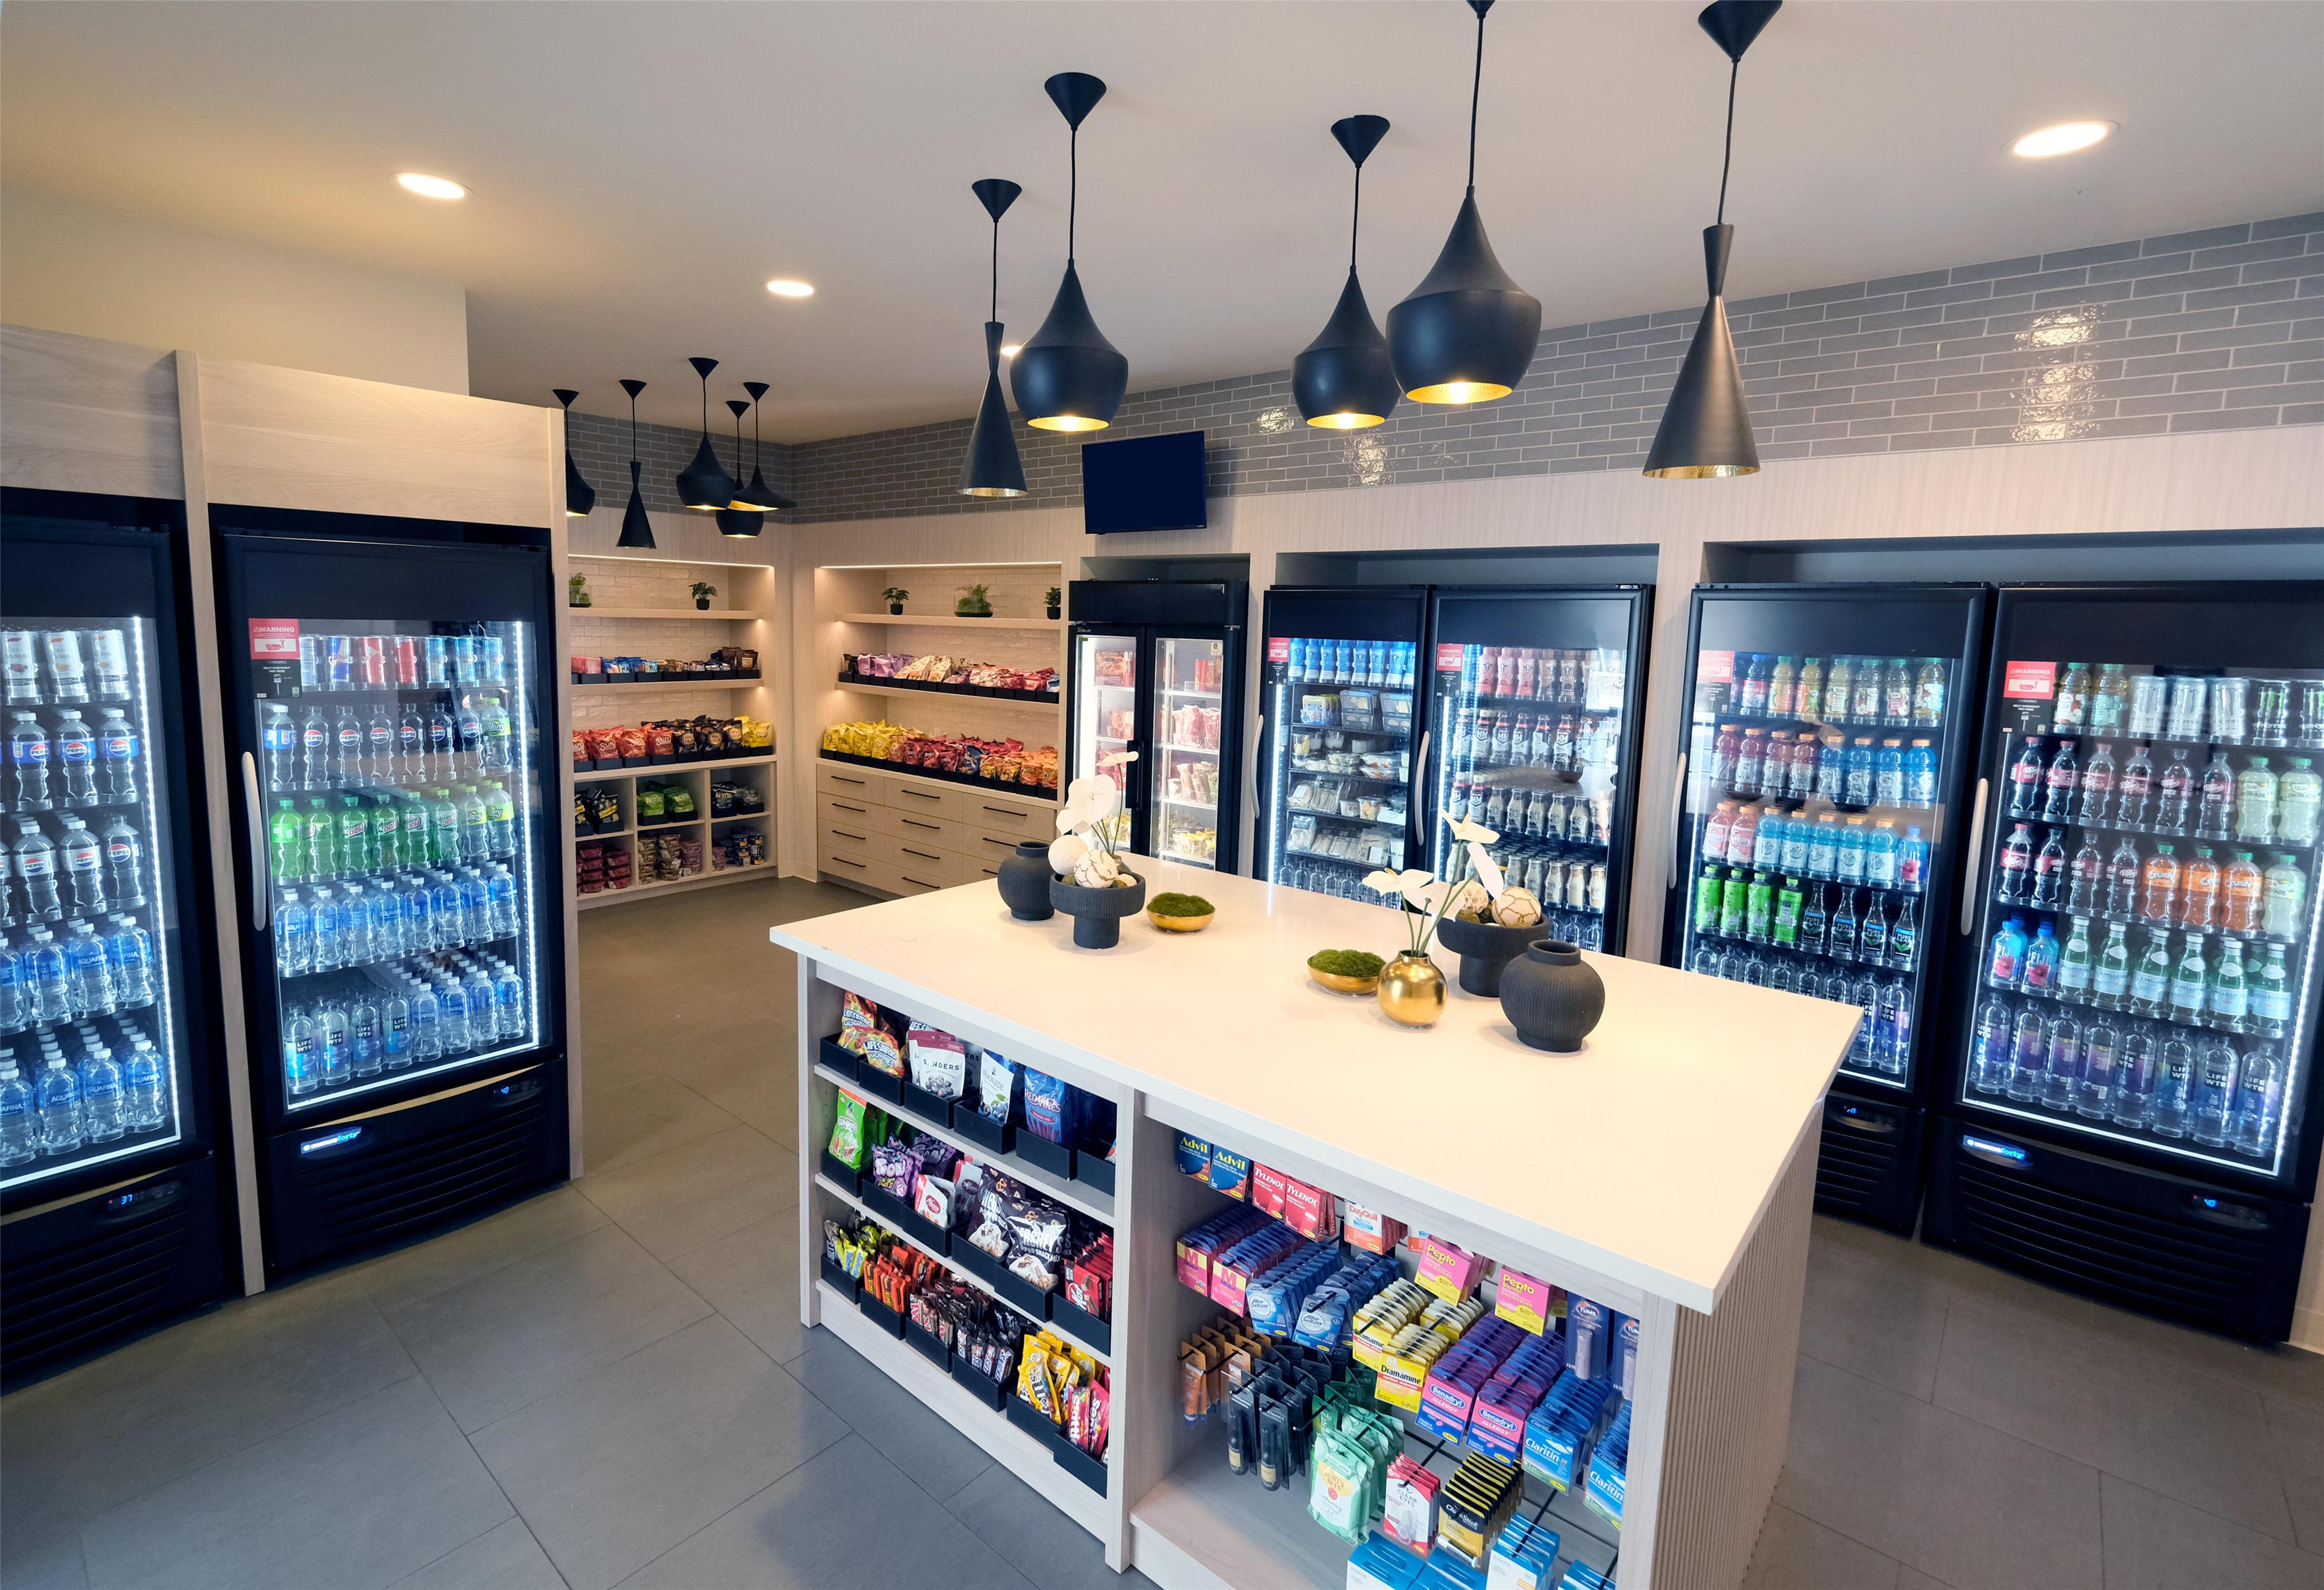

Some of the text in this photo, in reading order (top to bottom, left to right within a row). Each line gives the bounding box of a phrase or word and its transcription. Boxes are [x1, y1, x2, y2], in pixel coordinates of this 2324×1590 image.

[2148, 872, 2173, 880] Crush
[2225, 880, 2252, 889] Crush
[2205, 1079, 2227, 1088] WTR
[2206, 1072, 2227, 1081] LIFE
[2244, 1077, 2265, 1085] LIFE
[501, 1086, 510, 1094] 40
[2243, 1083, 2264, 1093] WTR
[1180, 1137, 1208, 1154] Advil
[1215, 1151, 1246, 1170] Advil
[1255, 1167, 1285, 1190] TYLENOL
[120, 1195, 133, 1205] 37
[1287, 1183, 1318, 1207] TYLENOL
[1349, 1204, 1378, 1222] DayQuil
[1050, 1254, 1061, 1263] MIX
[1426, 1251, 1444, 1265] Bismol
[1427, 1243, 1457, 1266] Pepto
[1501, 1281, 1522, 1294] Bismol
[1502, 1273, 1535, 1295] Pepto
[1579, 1307, 1597, 1317] TUMS
[1354, 1329, 1385, 1348] ramamin
[1381, 1364, 1421, 1385] Dramamine
[1431, 1397, 1458, 1413] ALLERGY
[1432, 1386, 1463, 1408] Benadryl
[1481, 1410, 1515, 1430] Benadryl
[1481, 1419, 1510, 1436] ALLERGY
[1525, 1437, 1560, 1464] Claritin
[1590, 1470, 1624, 1501] Claritin
[1397, 1488, 1417, 1503] CLEAR
[1399, 1495, 1416, 1508] EYES
[1445, 1503, 1480, 1528] ChaStick
